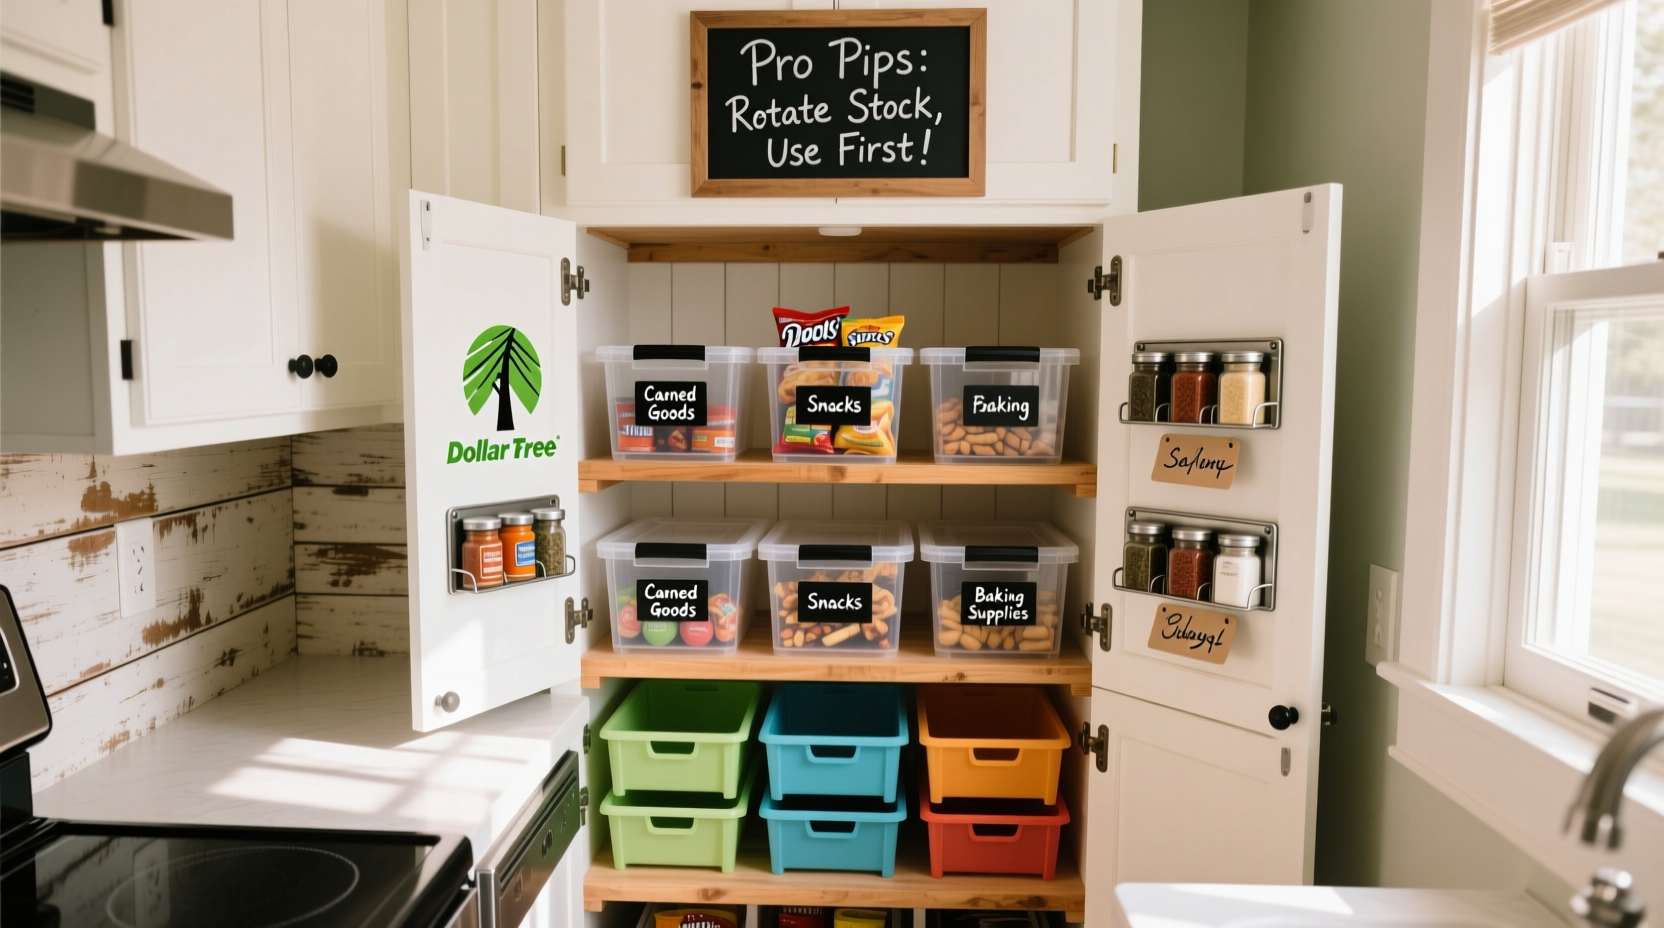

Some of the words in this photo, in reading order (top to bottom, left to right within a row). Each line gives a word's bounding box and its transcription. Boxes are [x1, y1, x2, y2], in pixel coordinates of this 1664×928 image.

[740, 39, 813, 86] Pro
[828, 37, 927, 89] Pips:
[725, 95, 832, 133] Rotate
[848, 86, 942, 125] Stock,
[767, 138, 821, 168] Use
[839, 129, 931, 166] First!
[648, 403, 695, 421] Goods
[807, 394, 862, 413] Snacks
[447, 438, 510, 464] Dollar
[513, 437, 557, 459] Tree
[807, 592, 863, 610] Snacks
[975, 586, 1025, 608] Baking
[650, 602, 697, 618] Goods
[968, 604, 1029, 625] Supplies
